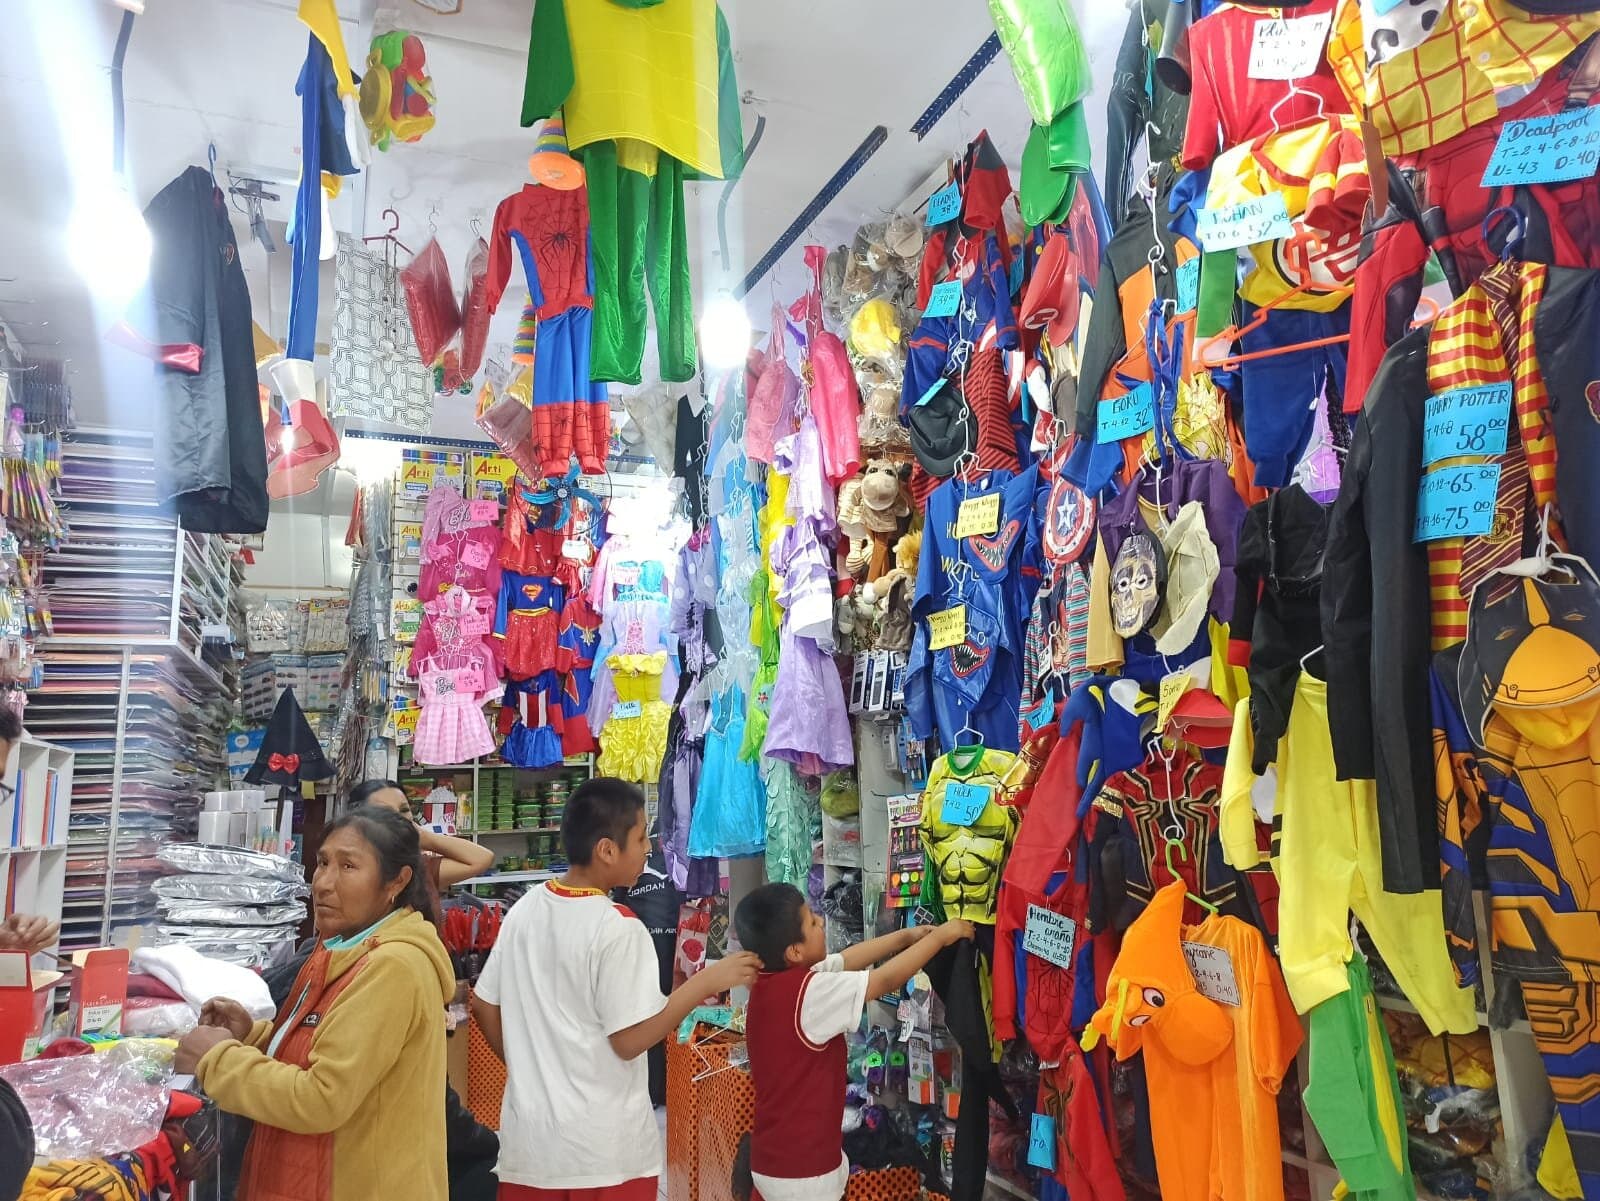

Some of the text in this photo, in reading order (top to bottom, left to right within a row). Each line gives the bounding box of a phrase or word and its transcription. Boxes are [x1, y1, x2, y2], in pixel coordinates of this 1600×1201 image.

[1507, 107, 1596, 143] Deadpool
[1459, 389, 1509, 408] POTTER
[404, 464, 430, 479] Arti
[475, 460, 502, 476] Arti
[628, 881, 665, 897] JORDAN
[1029, 906, 1065, 929] Hombre
